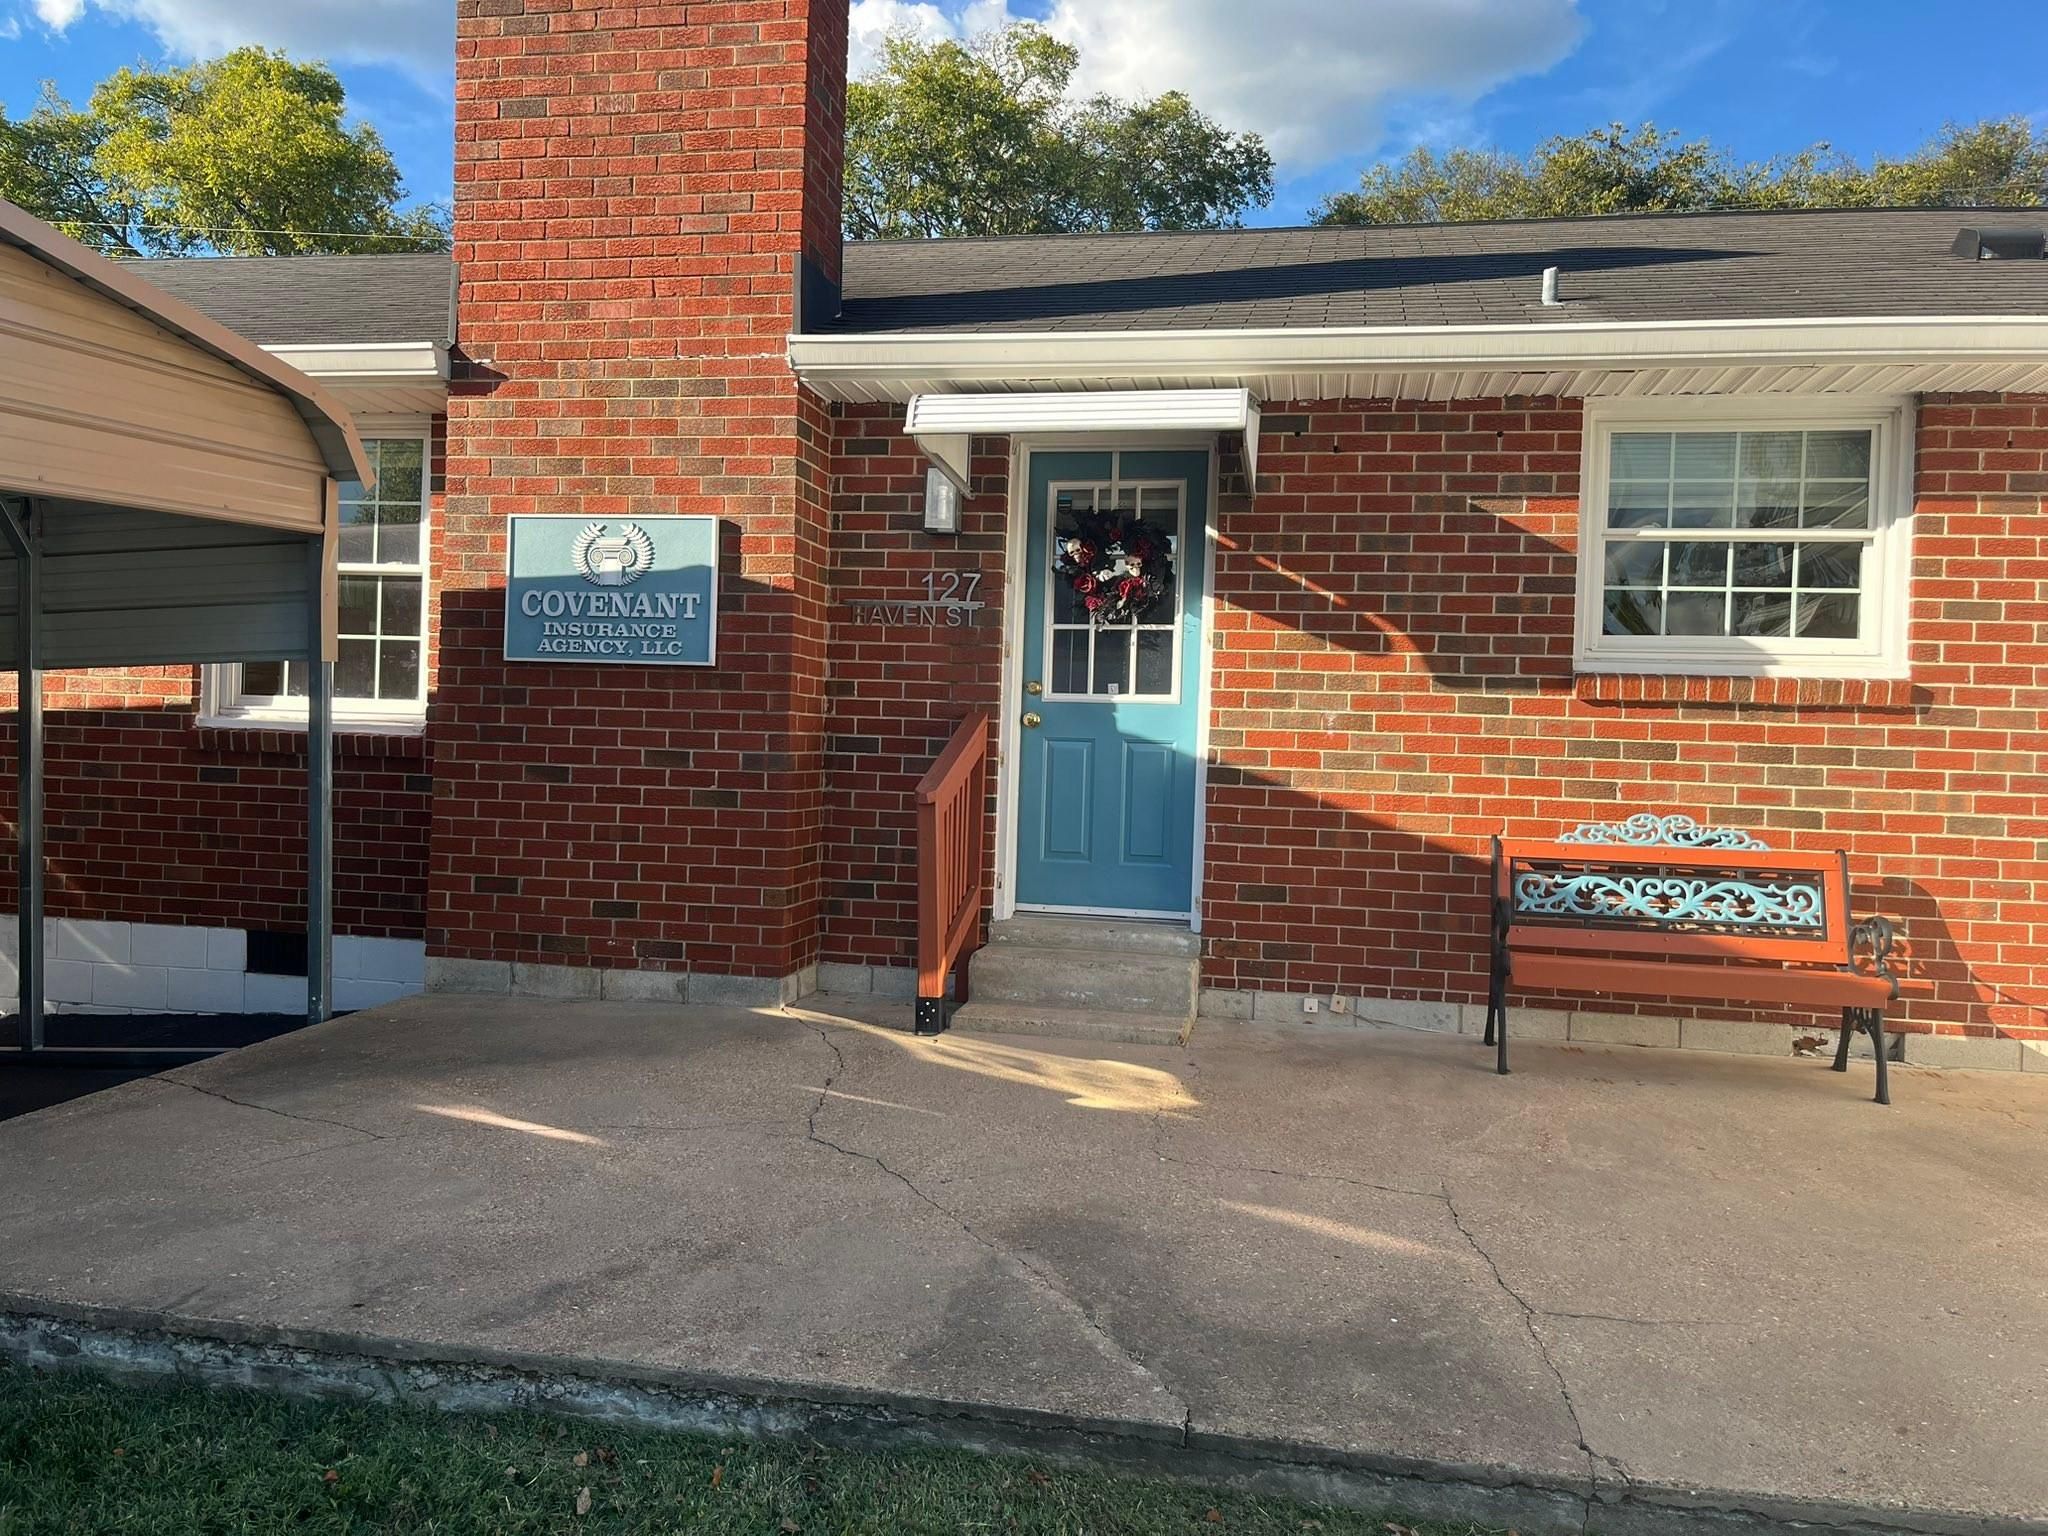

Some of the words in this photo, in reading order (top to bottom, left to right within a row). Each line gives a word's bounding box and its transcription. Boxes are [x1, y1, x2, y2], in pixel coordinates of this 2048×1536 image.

[921, 572, 982, 602] 127
[521, 590, 701, 619] COVENANT
[852, 604, 937, 627] HAVEN
[945, 605, 979, 627] ST
[543, 622, 677, 639] INSURANCE
[537, 638, 634, 657] AGENCY,
[640, 641, 683, 656] LLC
